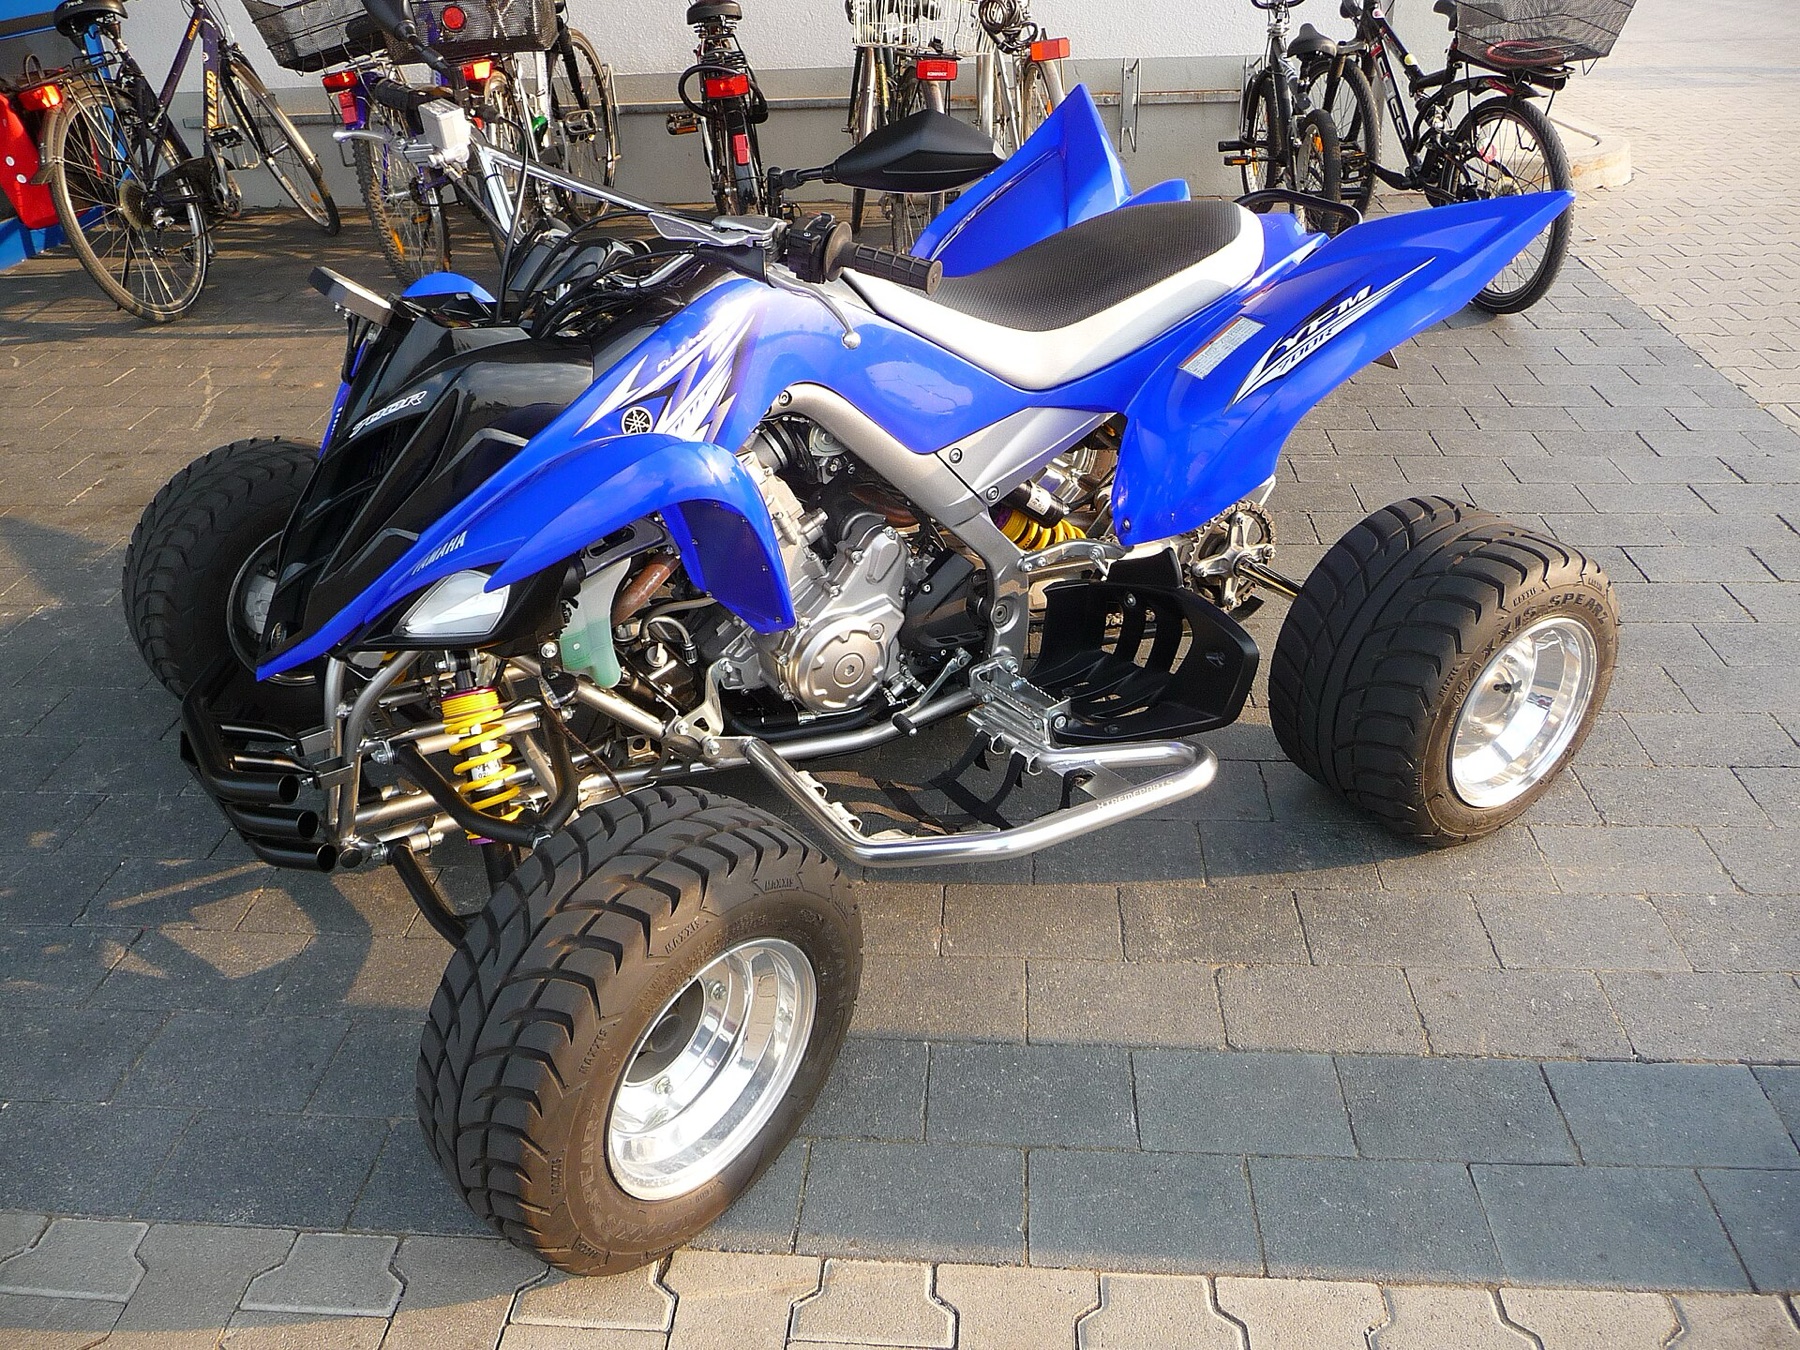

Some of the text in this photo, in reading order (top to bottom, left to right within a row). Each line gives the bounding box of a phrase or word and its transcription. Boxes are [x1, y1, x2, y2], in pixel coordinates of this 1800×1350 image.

[1277, 285, 1373, 352] YFM
[1278, 328, 1334, 372] 700R
[348, 391, 428, 438] 700R
[411, 530, 468, 576] YAMAHA
[1452, 592, 1609, 706] MAXXIS SPEARZ
